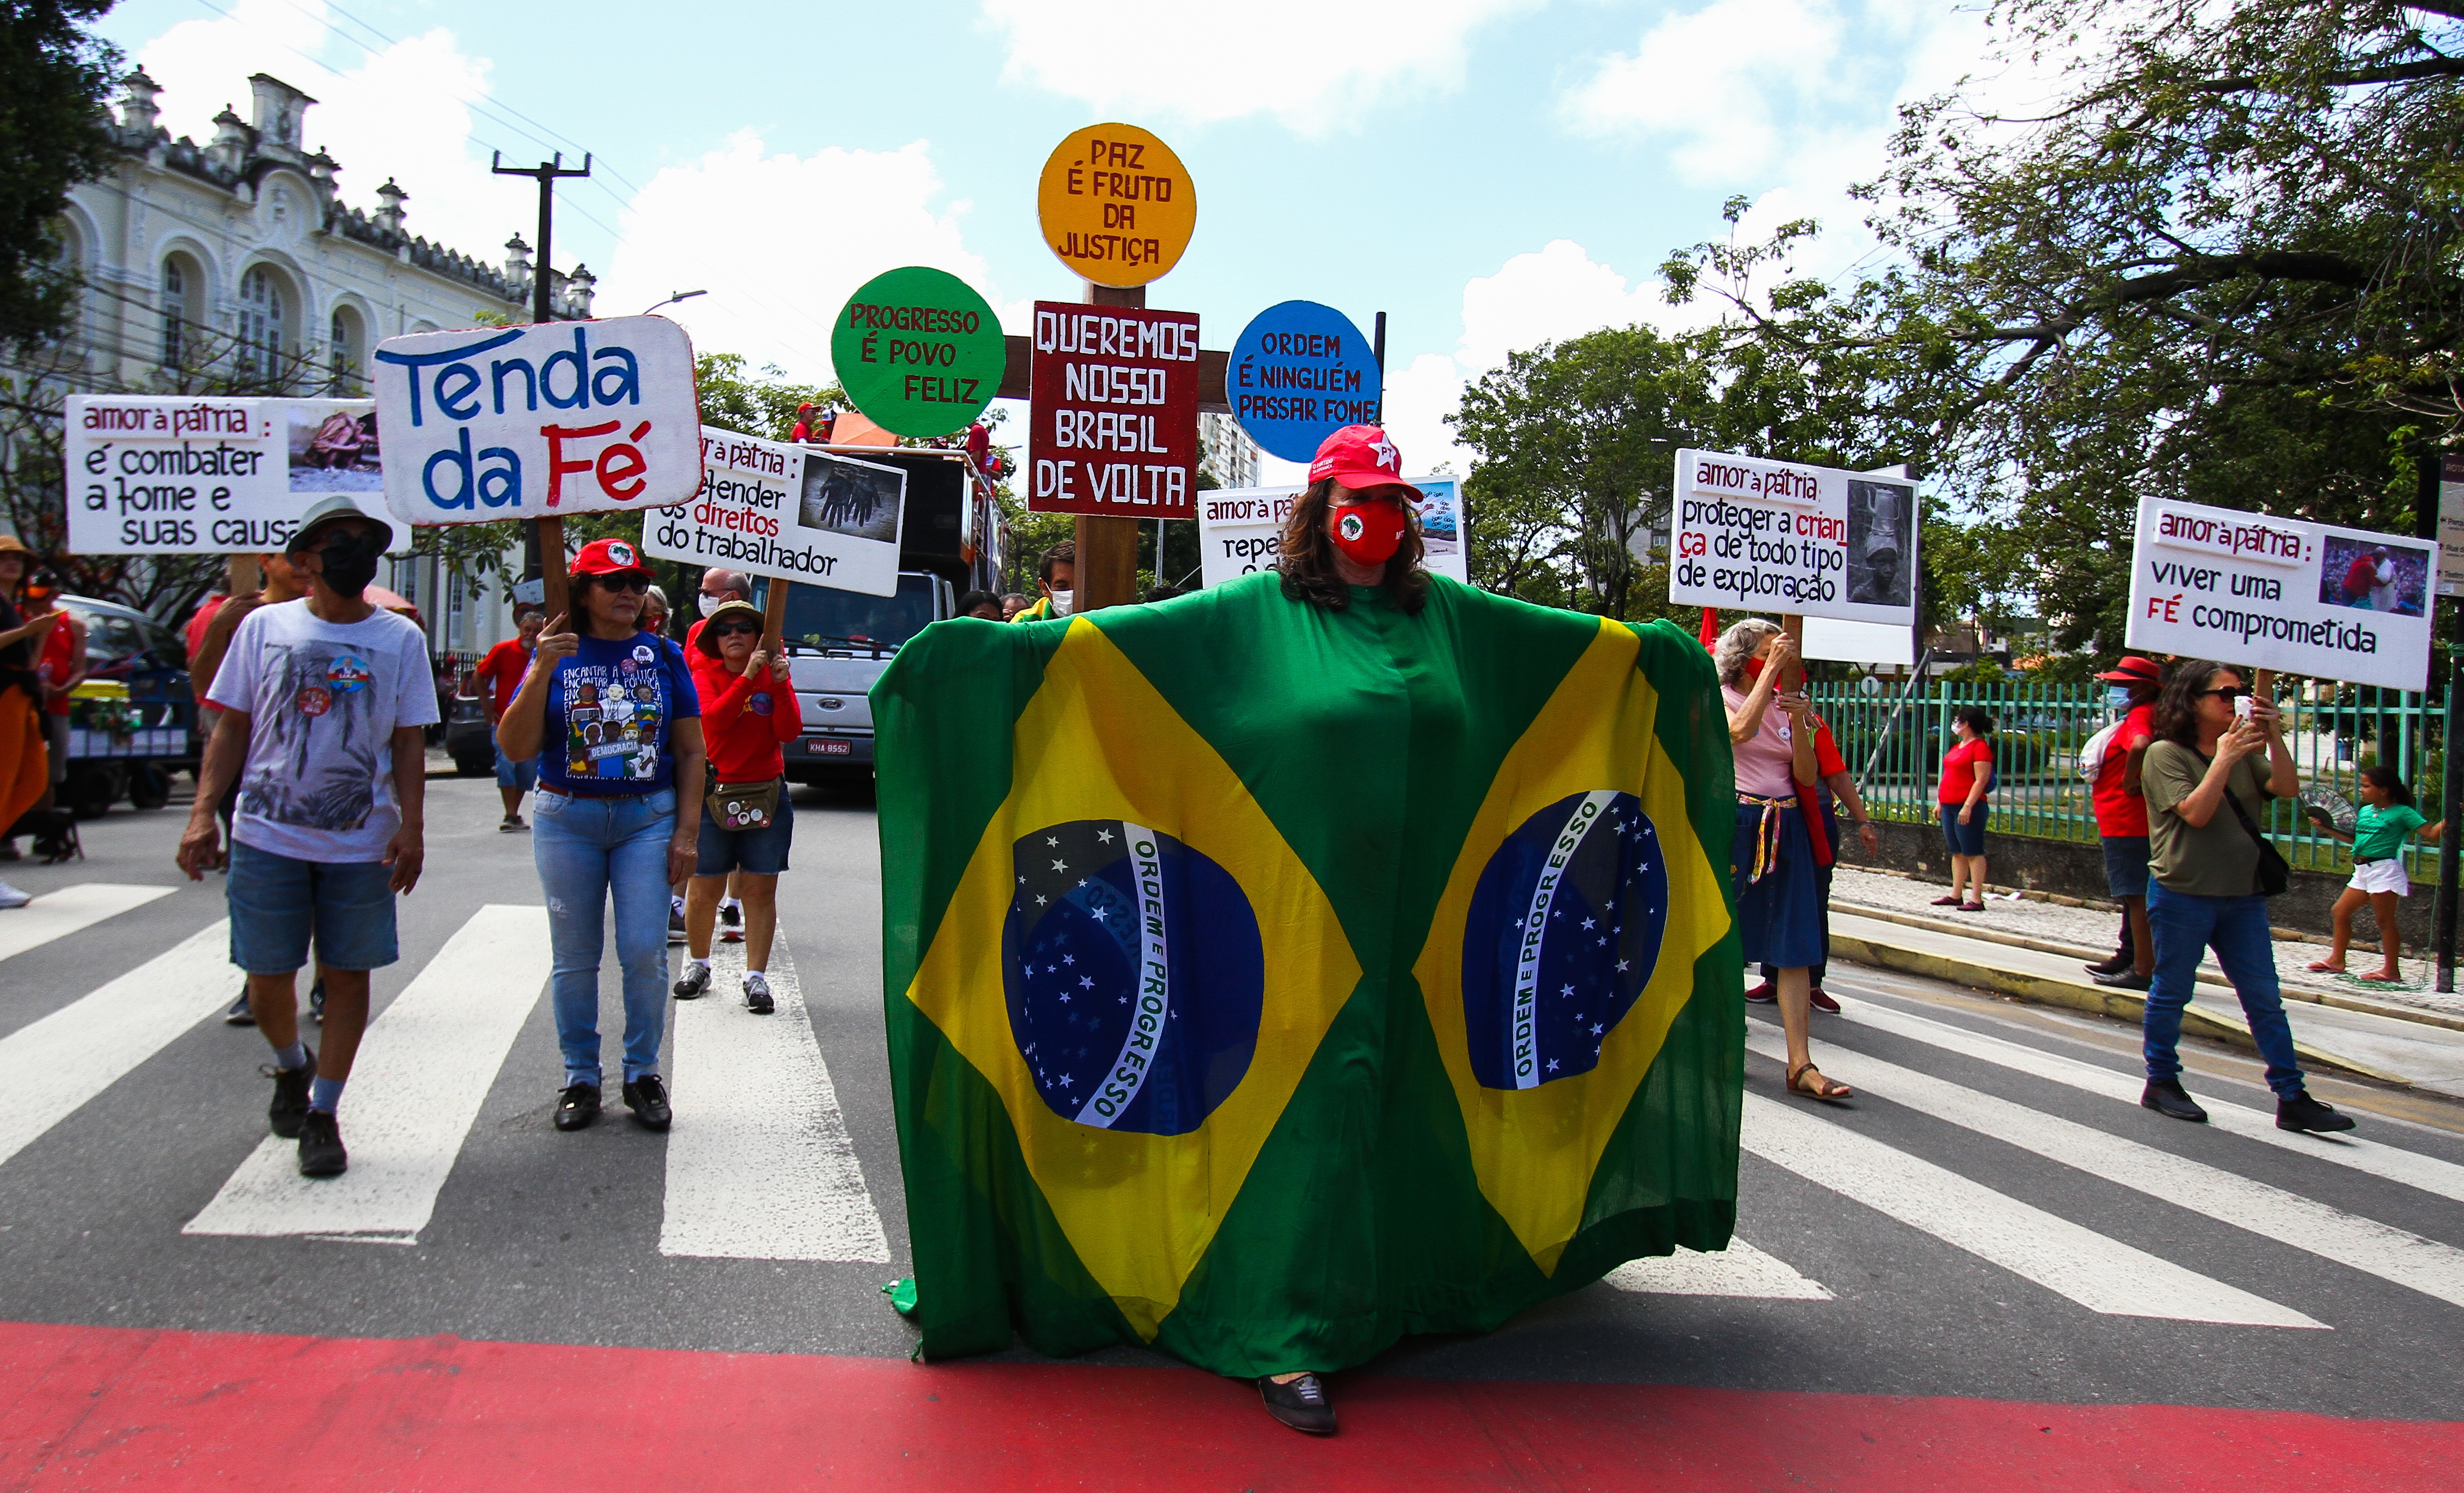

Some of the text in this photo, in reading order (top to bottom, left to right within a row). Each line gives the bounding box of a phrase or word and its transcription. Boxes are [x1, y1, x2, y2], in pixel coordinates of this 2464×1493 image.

[1091, 139, 1145, 170] PAZ
[1068, 160, 1171, 202] É FRUTO
[1103, 203, 1135, 230] DA
[1057, 231, 1159, 267] JUSTIÇA
[850, 302, 980, 334] PROGRESSO
[861, 330, 957, 367] É POVO
[1037, 311, 1197, 362] QUEREMOS
[1261, 332, 1341, 358] ORDEM
[374, 326, 639, 427] Tenda
[905, 375, 980, 404] FELIZ
[1066, 363, 1166, 405] NOSSO
[1239, 354, 1361, 393] É NINGUÉM
[84, 407, 152, 430] amor
[154, 408, 168, 430] à
[1239, 394, 1375, 424] PASSAR FOME
[1056, 409, 1168, 453] BRASIL
[85, 440, 265, 476] é combater
[422, 420, 652, 510] da Fé
[714, 441, 726, 461] à
[1036, 459, 1186, 506] DE VOLTA
[1697, 462, 1750, 488] amor
[1751, 472, 1761, 492] à
[86, 476, 232, 517] a fome e
[1207, 500, 1256, 520] amor
[1257, 499, 1269, 518] à
[121, 519, 198, 546] suas
[694, 502, 779, 537] direitos
[1682, 497, 1776, 540] proteger
[1778, 511, 1791, 534] a
[2160, 513, 2217, 543] amor
[2218, 522, 2231, 546] à
[657, 520, 838, 576] do trabalhador
[1679, 529, 1843, 577] ça de todo tipo
[1678, 558, 1835, 603] de exploração
[2151, 560, 2281, 601] viver uma
[2147, 594, 2376, 654] FÉ comprometida
[563, 665, 607, 680] ENCANTAR
[612, 665, 619, 678] A
[592, 741, 638, 758] DEMOCRACIA
[810, 744, 848, 753] KHA 8552
[1135, 840, 1164, 936] ORDEM
[1151, 944, 1164, 956] E
[1516, 800, 1598, 1078] ORDEM E PROGRESSO
[1094, 961, 1167, 1118] PROGRESSO
